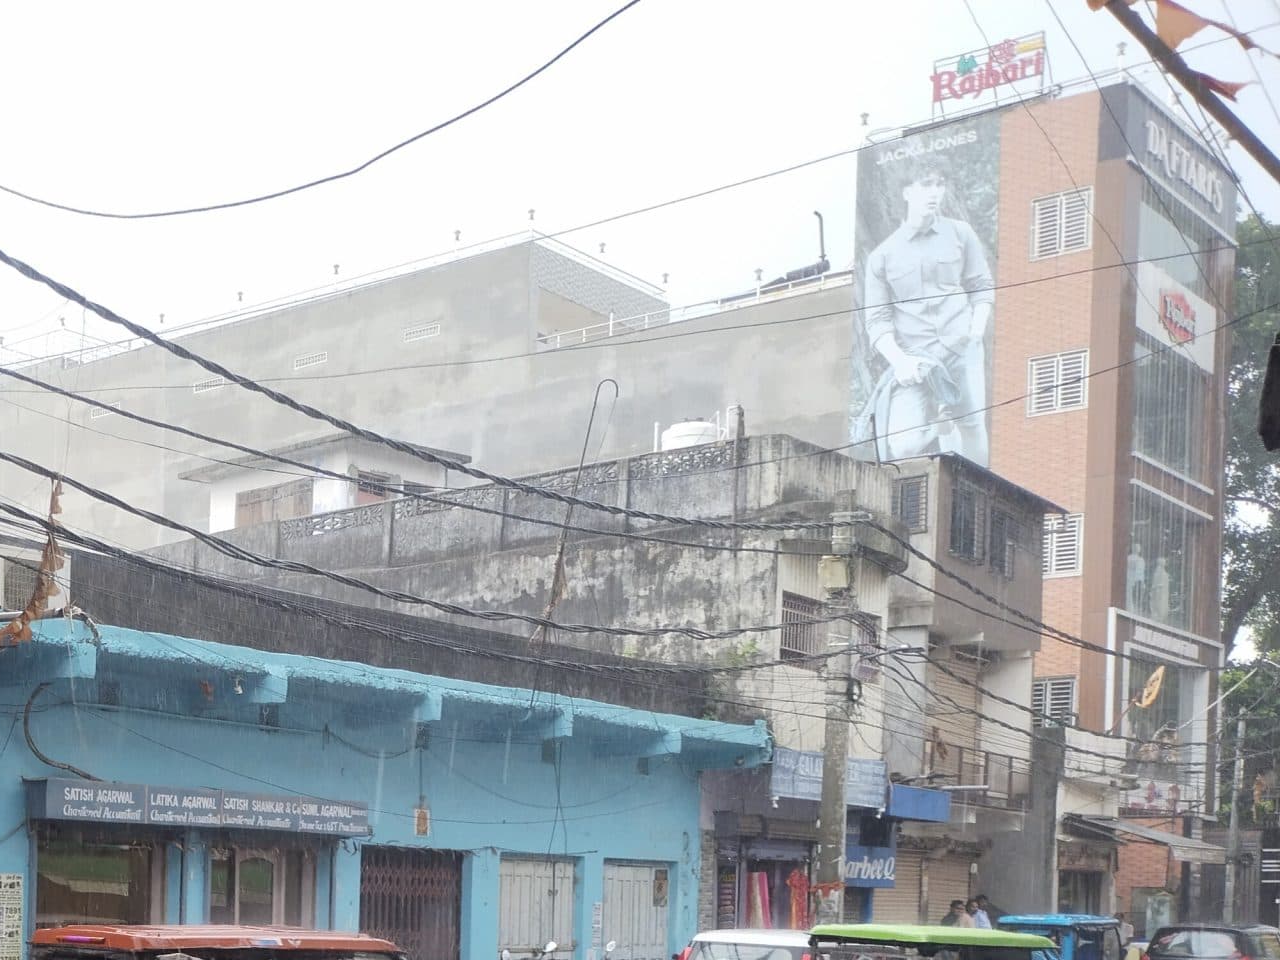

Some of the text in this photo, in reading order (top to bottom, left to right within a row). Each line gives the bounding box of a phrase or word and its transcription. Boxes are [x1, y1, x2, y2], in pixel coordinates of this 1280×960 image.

[930, 47, 1044, 103] Rajbari
[64, 787, 135, 804] SATISH AGARWAL
[150, 793, 217, 810] LATIKA AGARWAL
[63, 804, 102, 819] Chartered
[224, 797, 249, 811] SATISH
[252, 799, 284, 814] SHANKAR
[320, 804, 352, 818] AGARWAL
[839, 855, 896, 881] arbeeQ
